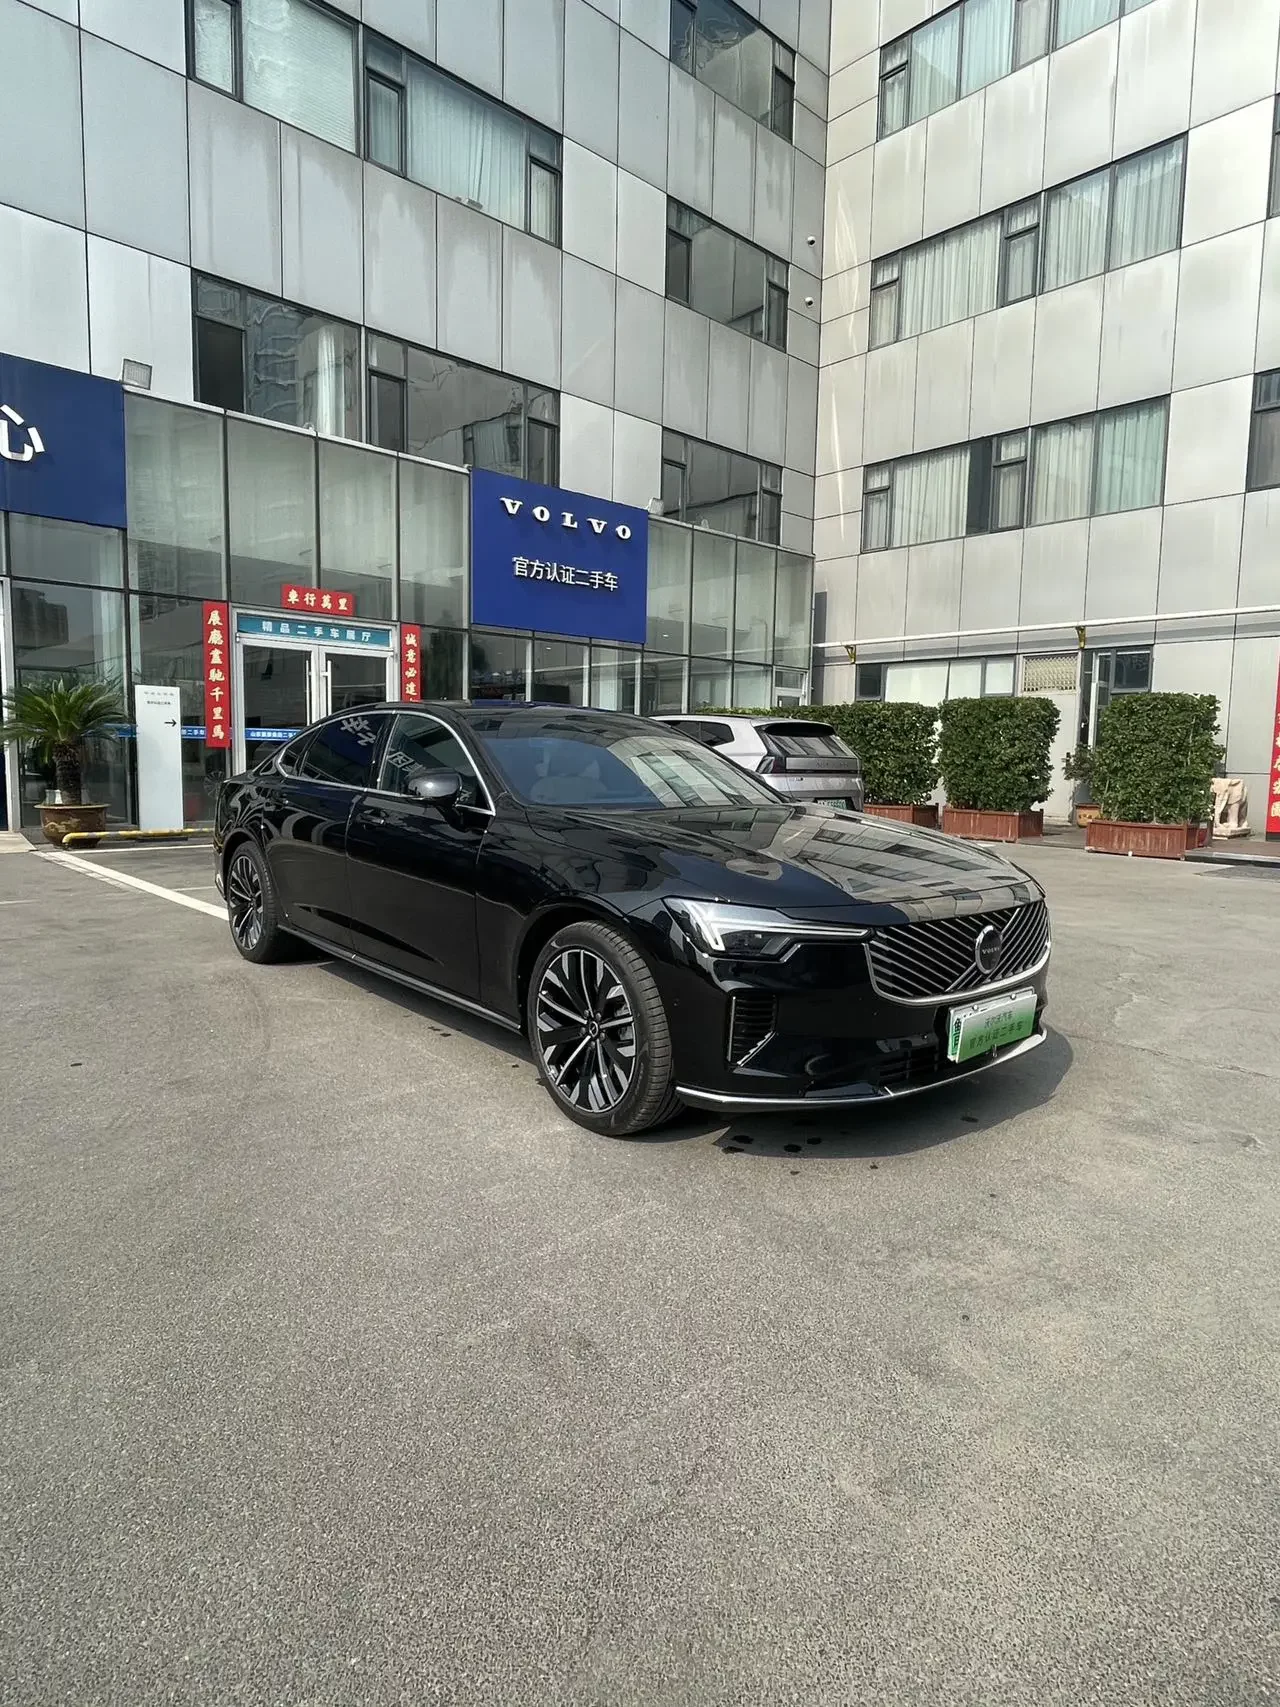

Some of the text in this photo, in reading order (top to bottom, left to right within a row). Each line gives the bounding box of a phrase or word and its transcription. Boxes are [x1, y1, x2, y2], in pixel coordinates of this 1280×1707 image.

[500, 497, 632, 540] VOLVO
[512, 556, 618, 591] 官方认证二手车
[262, 620, 371, 642] 精品二手车展厅
